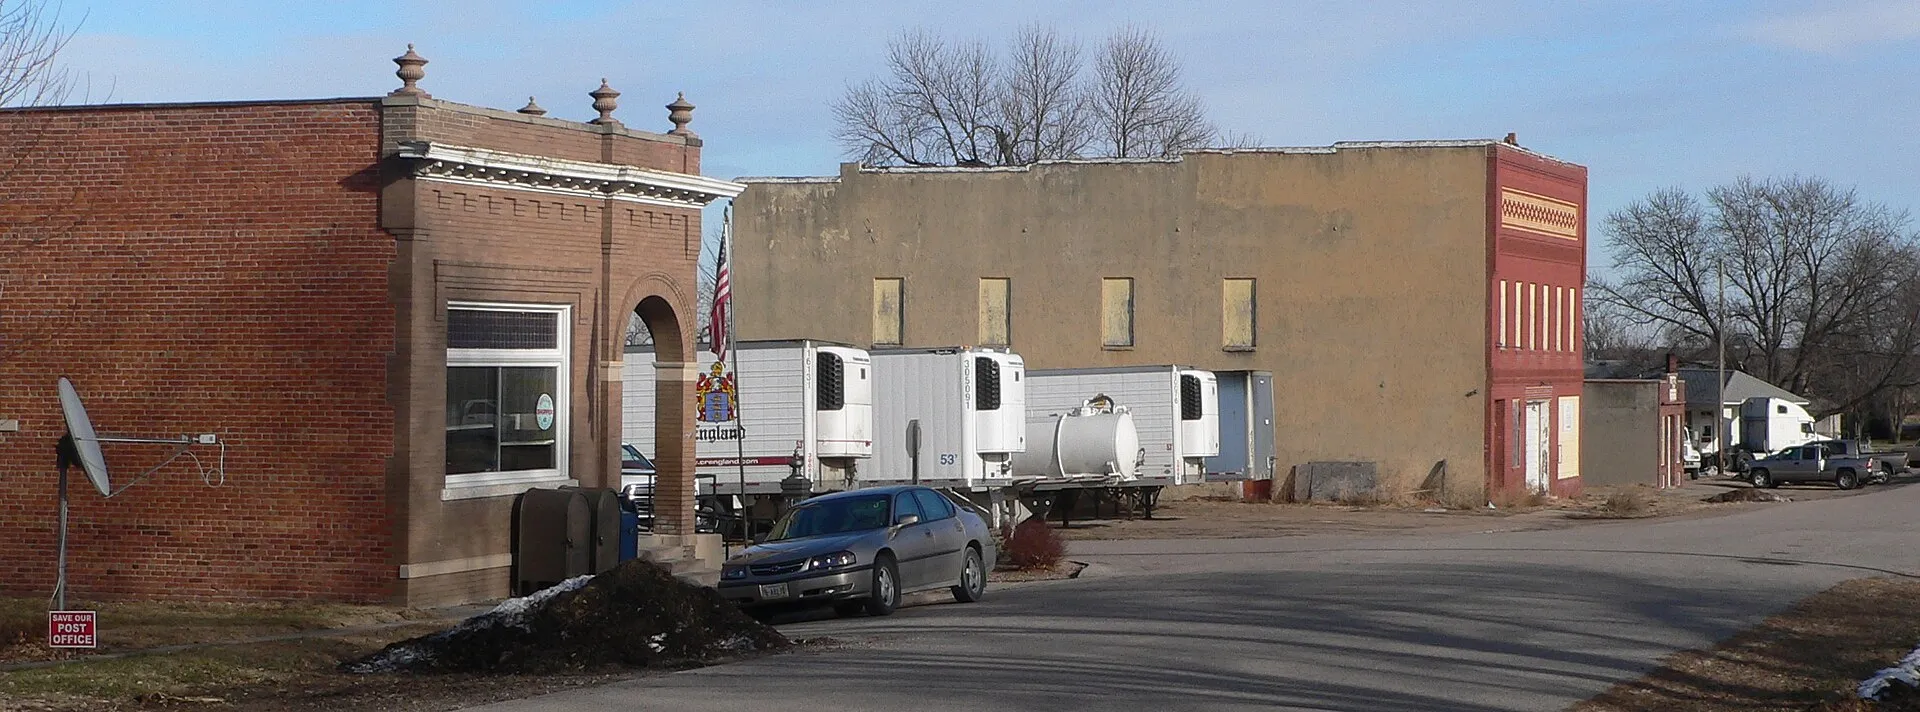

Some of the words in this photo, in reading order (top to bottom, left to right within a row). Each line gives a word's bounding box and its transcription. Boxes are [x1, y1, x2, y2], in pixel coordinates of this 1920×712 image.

[940, 454, 958, 465] 53'
[52, 614, 73, 622] SAVE
[74, 614, 92, 622] OUR
[58, 623, 87, 633] POST
[53, 634, 92, 644] OFFICE
